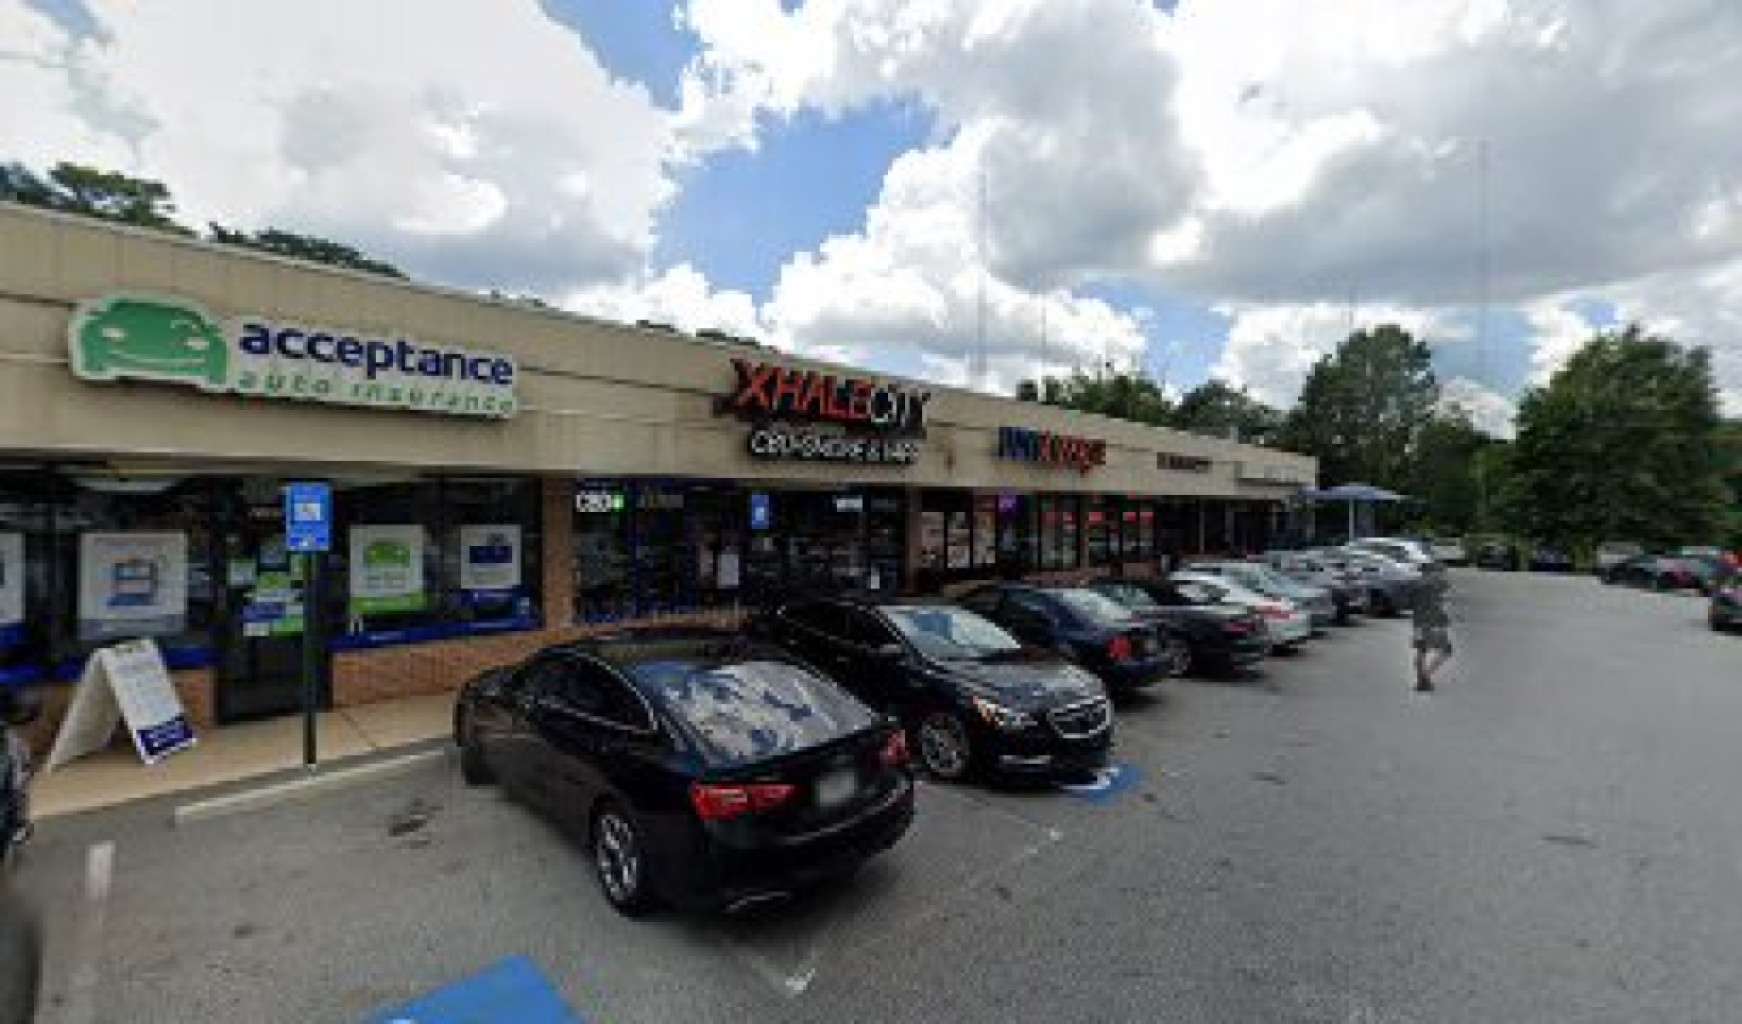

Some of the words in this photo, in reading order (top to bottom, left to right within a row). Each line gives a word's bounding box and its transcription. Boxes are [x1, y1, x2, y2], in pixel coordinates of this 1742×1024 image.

[241, 323, 513, 385] acceptance
[239, 371, 330, 391] auto
[351, 382, 513, 412] insurance
